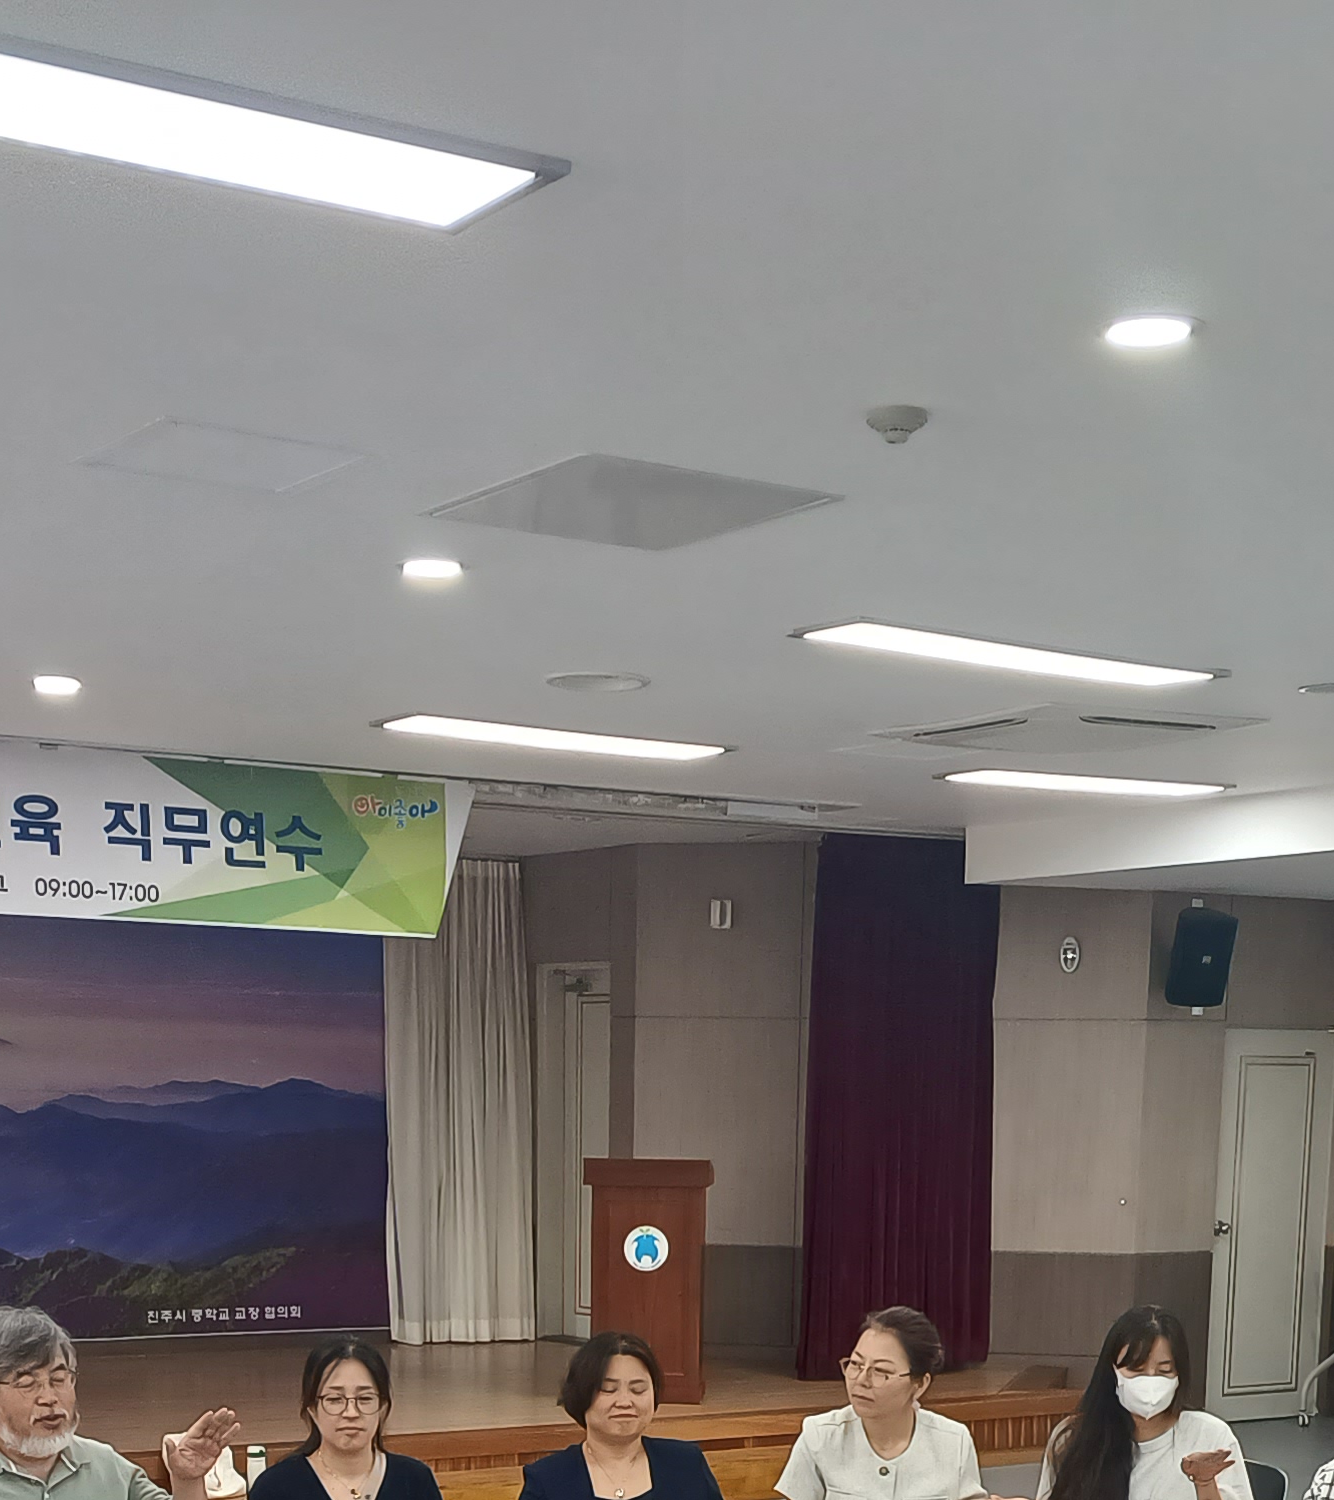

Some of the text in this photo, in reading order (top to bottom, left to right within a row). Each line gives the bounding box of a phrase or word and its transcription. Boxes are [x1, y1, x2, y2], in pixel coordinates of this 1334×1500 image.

[353, 795, 438, 829] 아이좋아
[103, 799, 324, 873] 직무연수
[34, 878, 160, 905] 09:00~17:00
[147, 1309, 186, 1324] 진주시
[234, 1307, 260, 1321] 교장
